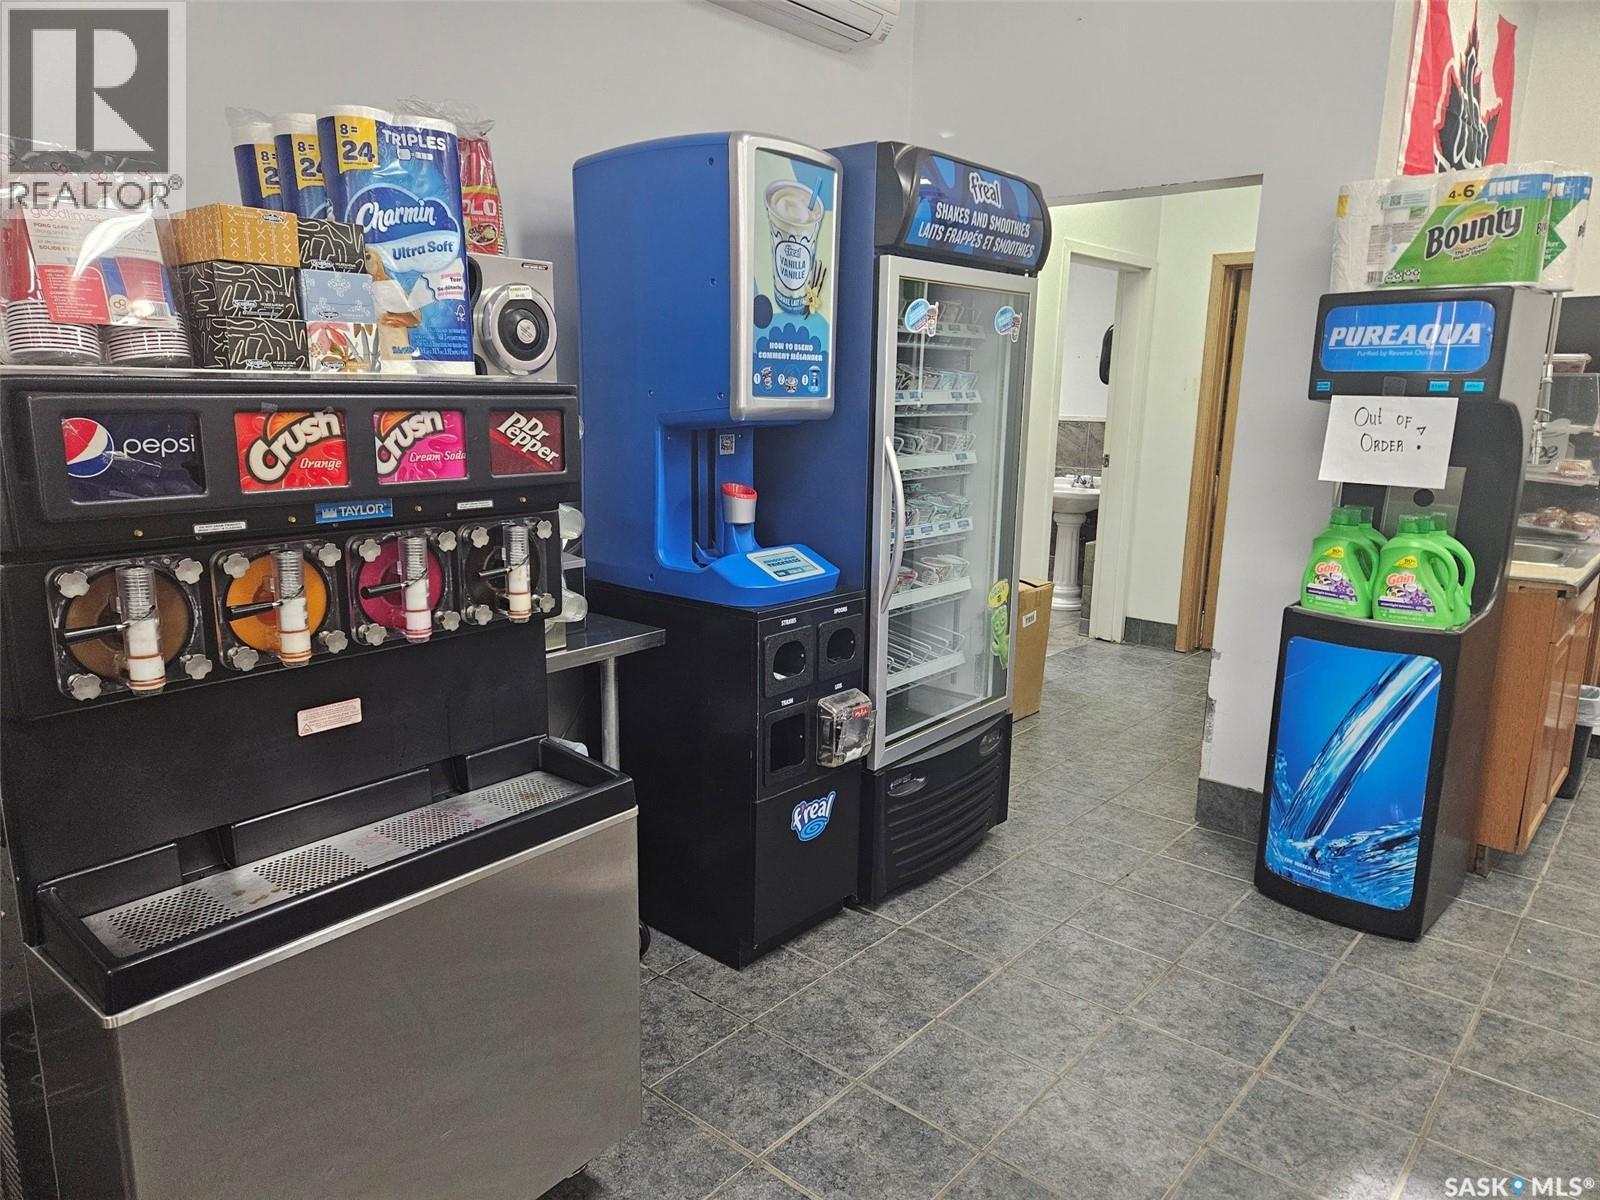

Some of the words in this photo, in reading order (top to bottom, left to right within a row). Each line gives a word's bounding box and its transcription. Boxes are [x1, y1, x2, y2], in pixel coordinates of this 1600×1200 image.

[382, 128, 447, 151] TRIPLES
[341, 140, 376, 163] 24
[355, 200, 437, 234] Charmin
[936, 202, 970, 226] SHAKES
[971, 211, 988, 230] AND
[989, 215, 1031, 239] SMOOTHIES
[918, 221, 946, 241] LAITS
[943, 226, 983, 248] FRAPPÉS
[982, 236, 993, 250] ET
[993, 238, 1035, 259] SMOOTHIES
[1425, 206, 1523, 260] Bounty
[392, 246, 426, 262] Ultra
[427, 240, 454, 255] Soft
[769, 342, 785, 350] HOW
[1328, 323, 1481, 349] PUREAQUA
[758, 351, 790, 360] COMMENT
[520, 416, 550, 440] Dr
[1354, 406, 1382, 427] Out
[123, 434, 196, 458] pepsi
[248, 410, 340, 482] Crush
[496, 410, 559, 465] Pepper
[1360, 433, 1404, 453] ORDER
[300, 457, 342, 471] Orange
[409, 451, 441, 463] Cream
[443, 450, 466, 461] Soda
[338, 503, 385, 516] TAYLOR
[1315, 562, 1341, 575] Gain
[1386, 573, 1416, 586] Gain
